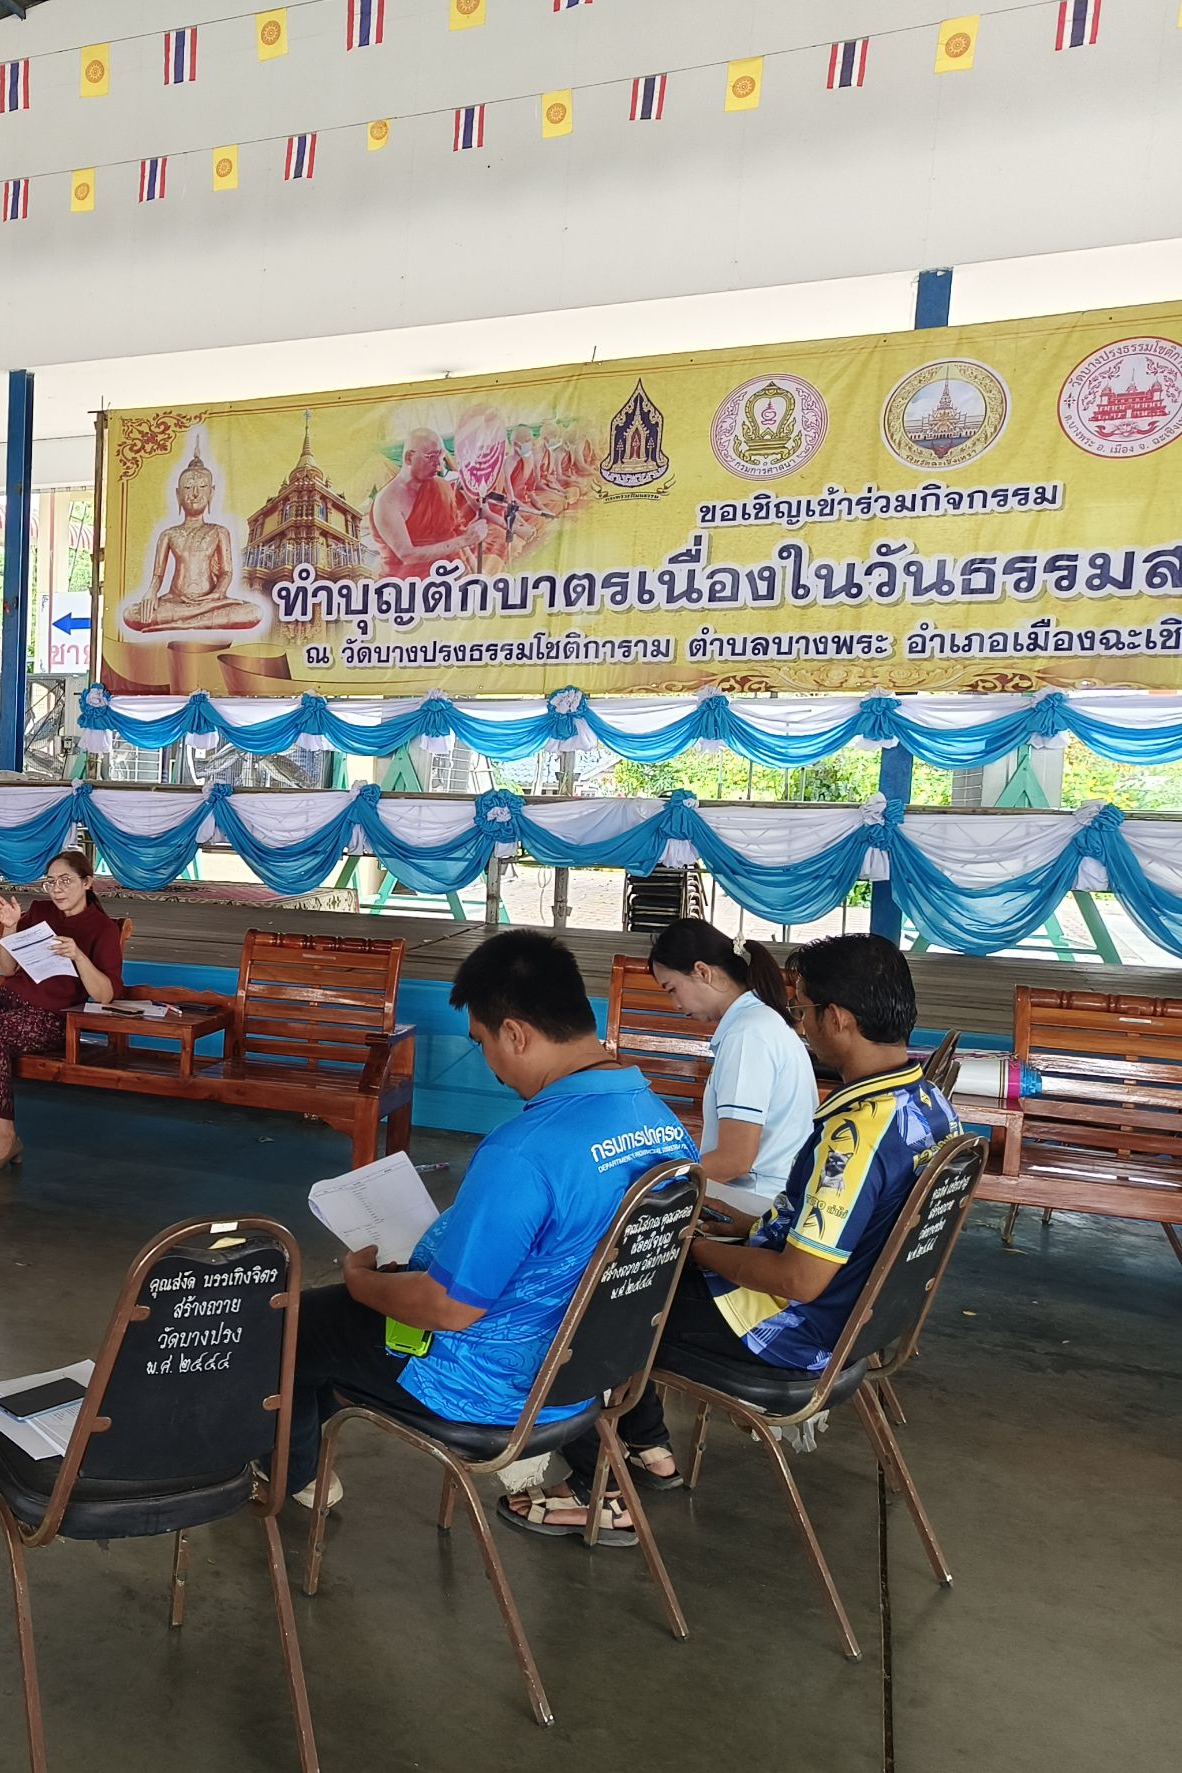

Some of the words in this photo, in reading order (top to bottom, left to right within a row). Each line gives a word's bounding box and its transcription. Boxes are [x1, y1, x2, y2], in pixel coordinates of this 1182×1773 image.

[734, 458, 796, 475] กรมการศาสนา
[698, 483, 1059, 526] ขอเชิญเข้าร่วมกิจกรรม
[276, 534, 1182, 635] ทำบุญตักบาตรเนื่องในวันธรรมส
[305, 644, 330, 665] ณ
[341, 631, 671, 665] วัดบางปรงธรรมโชติการาม
[688, 627, 889, 657] ตำบลบางพระ
[203, 1265, 279, 1288] บรรเทิงจิตร
[173, 1295, 242, 1319] สร้างถวาย
[157, 1321, 243, 1349] วัดบางปรง
